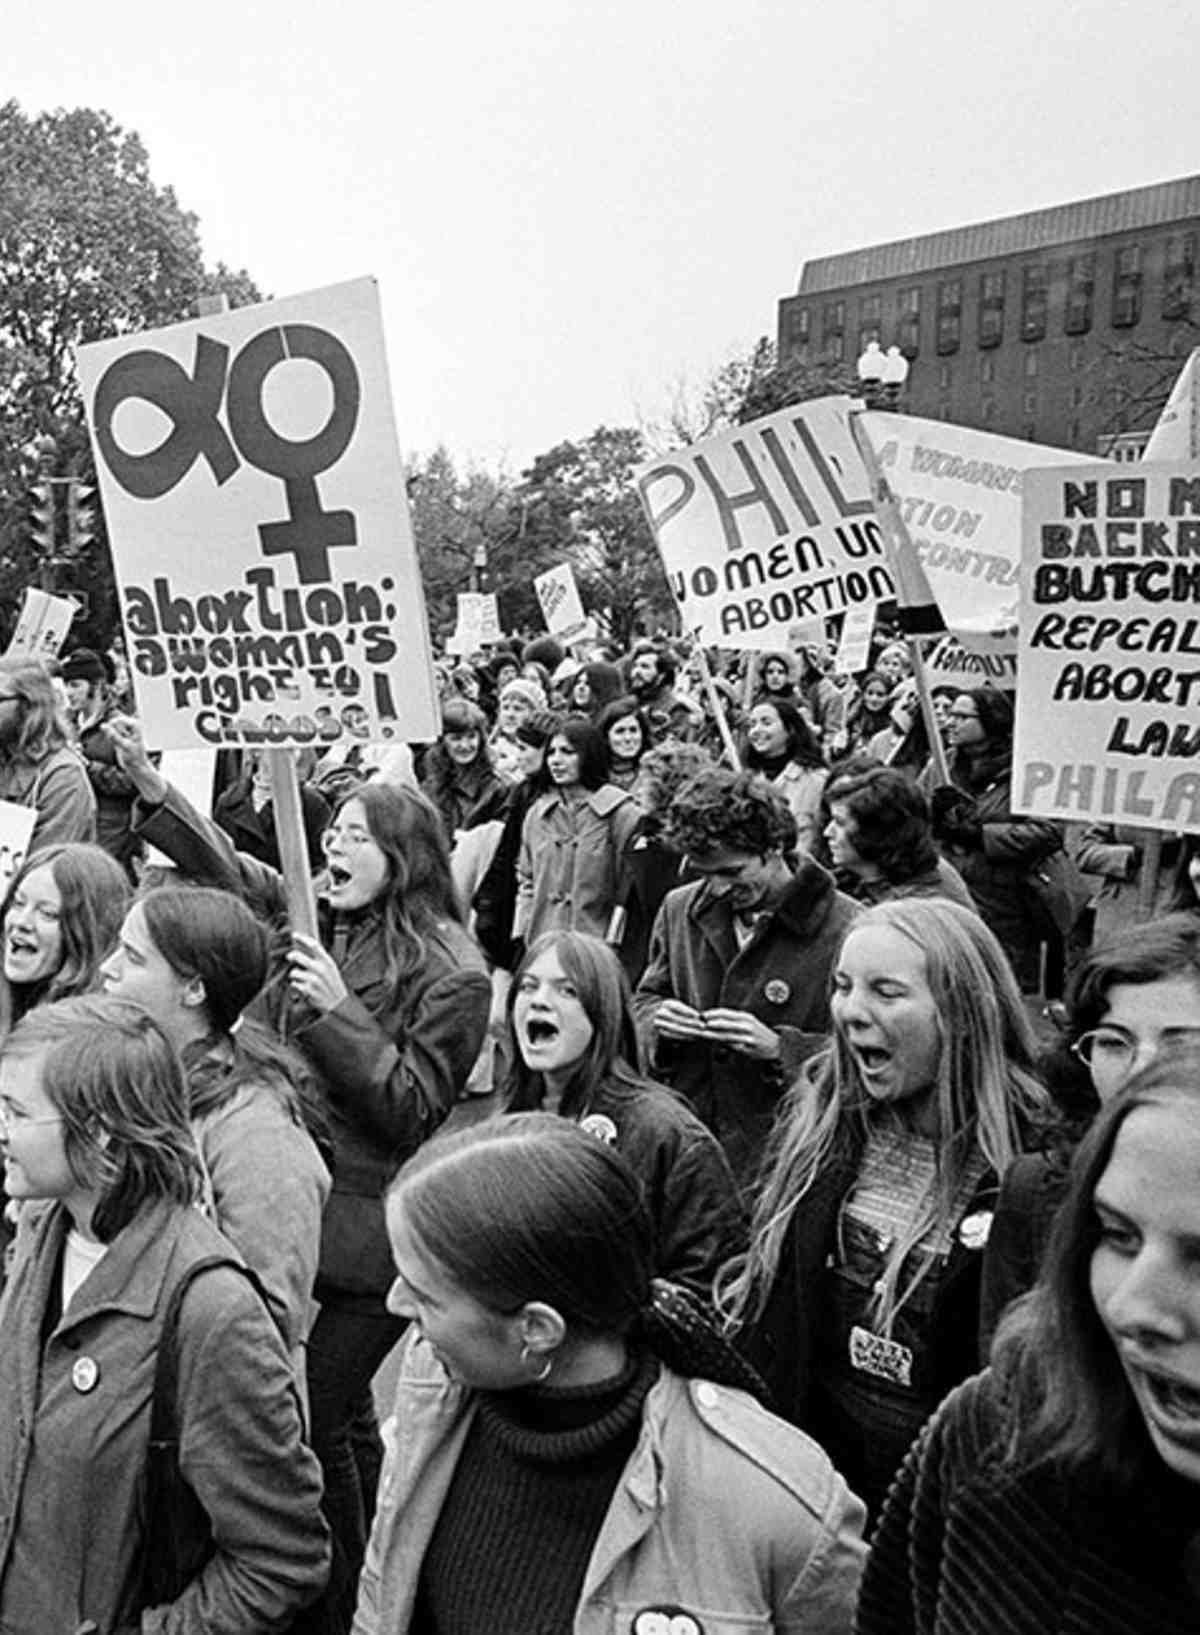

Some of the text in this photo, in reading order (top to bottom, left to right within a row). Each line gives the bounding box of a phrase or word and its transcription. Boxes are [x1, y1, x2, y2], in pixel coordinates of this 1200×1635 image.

[1063, 478, 1146, 518] NO
[1030, 613, 1200, 654] REPEAL
[172, 664, 361, 714] right to
[1021, 761, 1200, 824] PHILA
